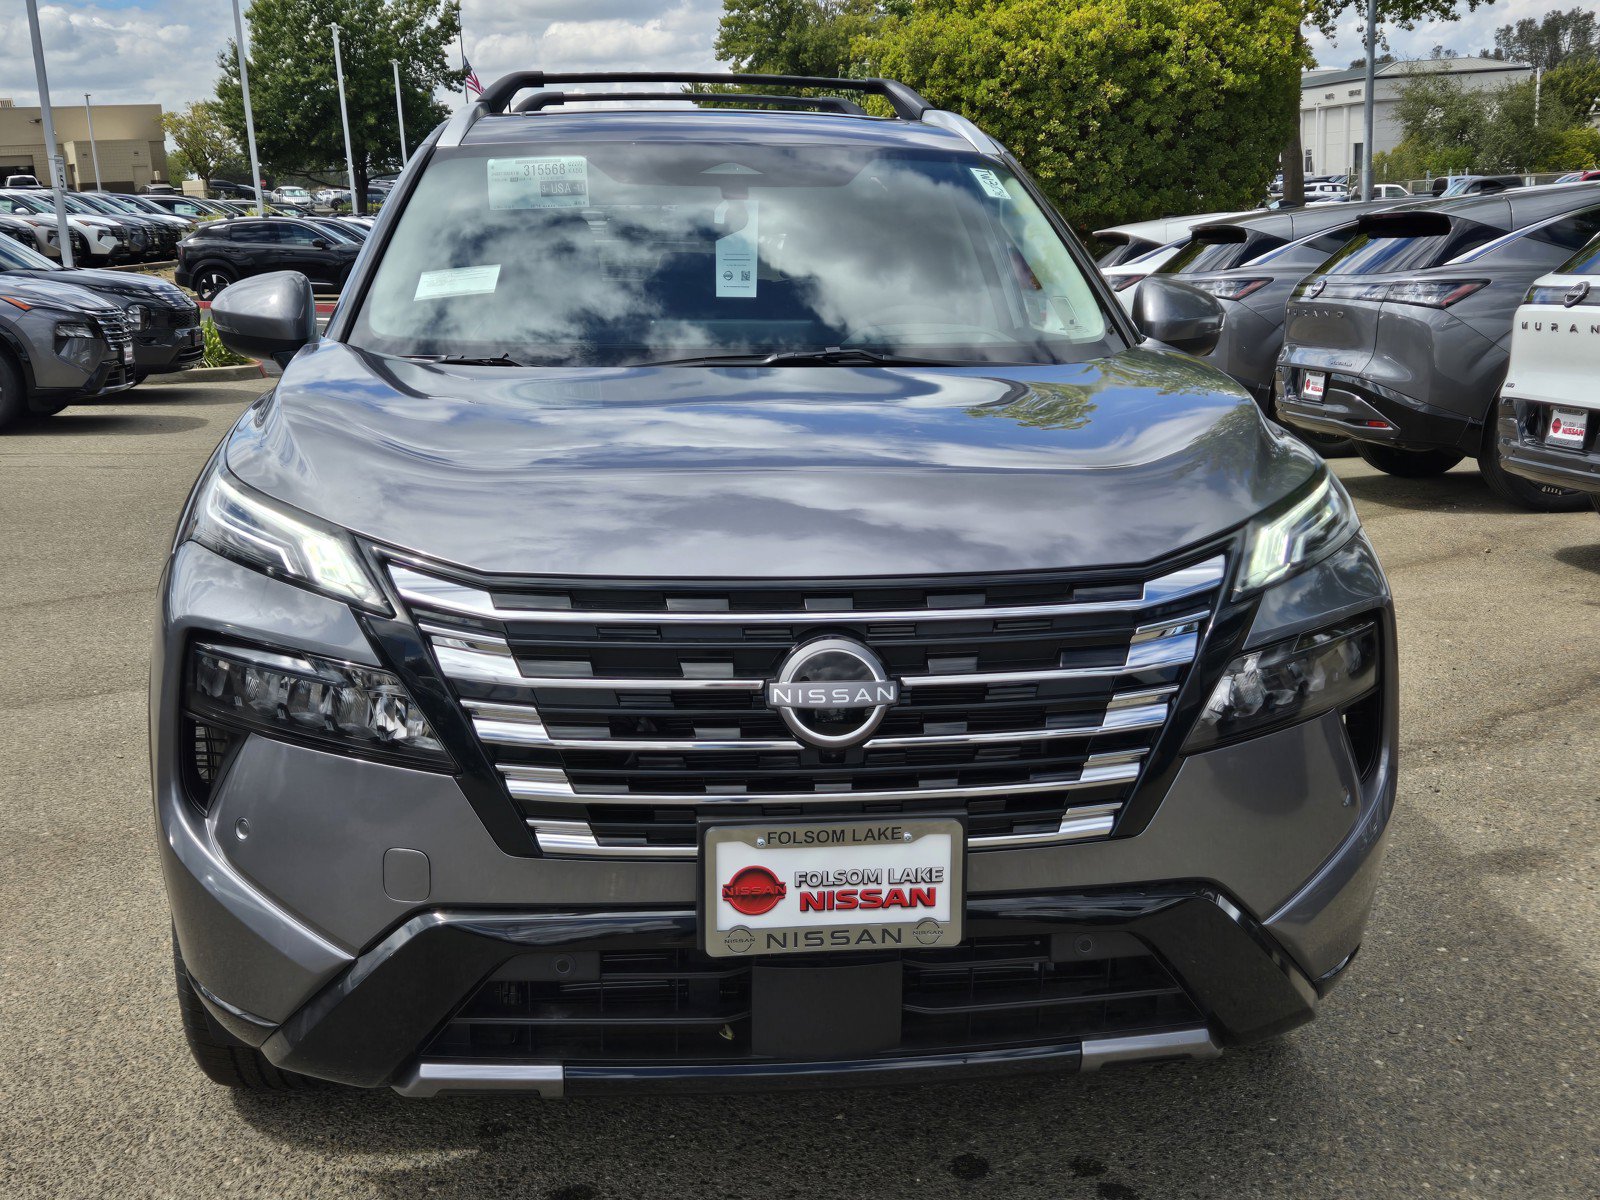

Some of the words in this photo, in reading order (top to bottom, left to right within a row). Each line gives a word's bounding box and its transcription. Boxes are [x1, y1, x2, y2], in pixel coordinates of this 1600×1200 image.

[523, 163, 566, 176] 315568
[551, 183, 571, 193] USA
[773, 686, 894, 703] NISSAN
[767, 829, 845, 844] FOLSOM
[852, 826, 902, 841] LAKE
[794, 868, 882, 887] FOLSOM
[888, 866, 944, 884] LAKE
[722, 881, 787, 897] NISSAN
[799, 887, 936, 912] NISSAN
[766, 928, 902, 949] NISSAN
